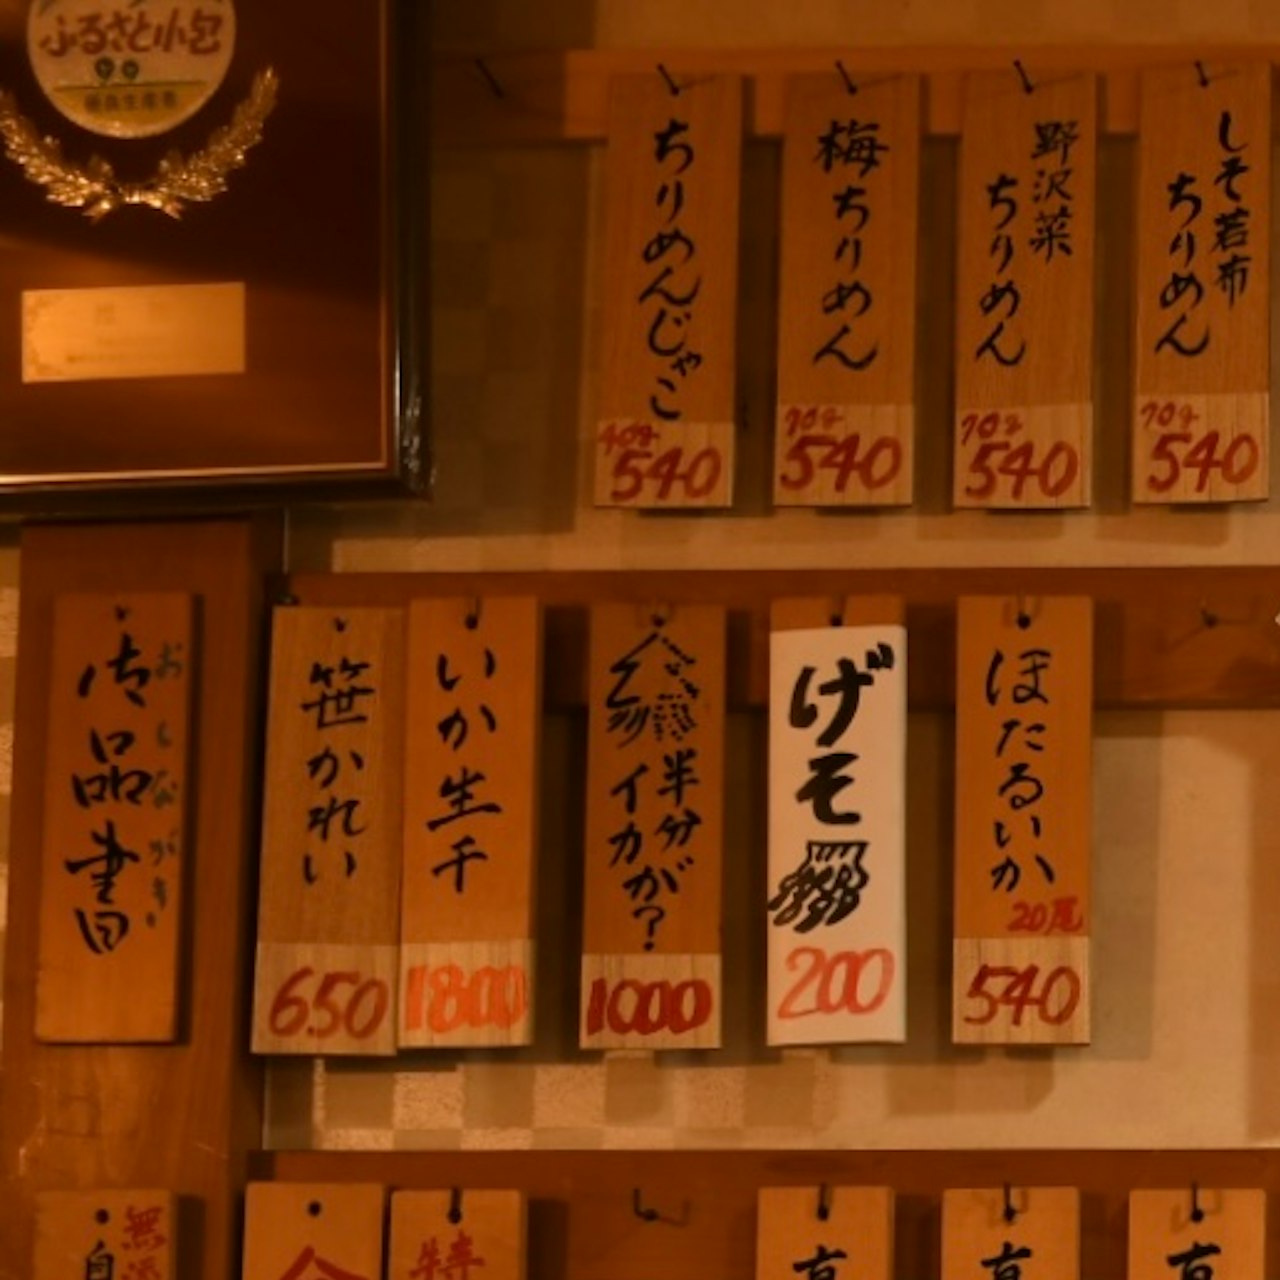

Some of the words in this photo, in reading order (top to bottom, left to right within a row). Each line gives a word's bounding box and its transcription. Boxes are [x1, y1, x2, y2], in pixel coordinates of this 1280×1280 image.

[40, 8, 222, 56] ふるさと小包
[813, 119, 891, 370] 梅ちりめん
[1028, 120, 1080, 264] 野沢菜
[1211, 109, 1251, 308] しそ若布
[639, 119, 702, 420] ちりめんじゃこ
[973, 172, 1026, 368] ちりめん
[1154, 171, 1211, 357] ちりめん
[611, 447, 721, 501] 540
[781, 433, 902, 492] 540
[965, 440, 1079, 499] 540
[1148, 432, 1260, 494] 540
[300, 656, 376, 885] 笹かれい
[425, 648, 504, 893] いか生干
[791, 643, 894, 826] げそ
[986, 650, 1056, 893] ほたるいか
[268, 967, 389, 1040] 650
[403, 965, 525, 1033] 1800
[587, 980, 712, 1036] 1000
[778, 948, 894, 1020] 200
[963, 964, 1082, 1028] 540
